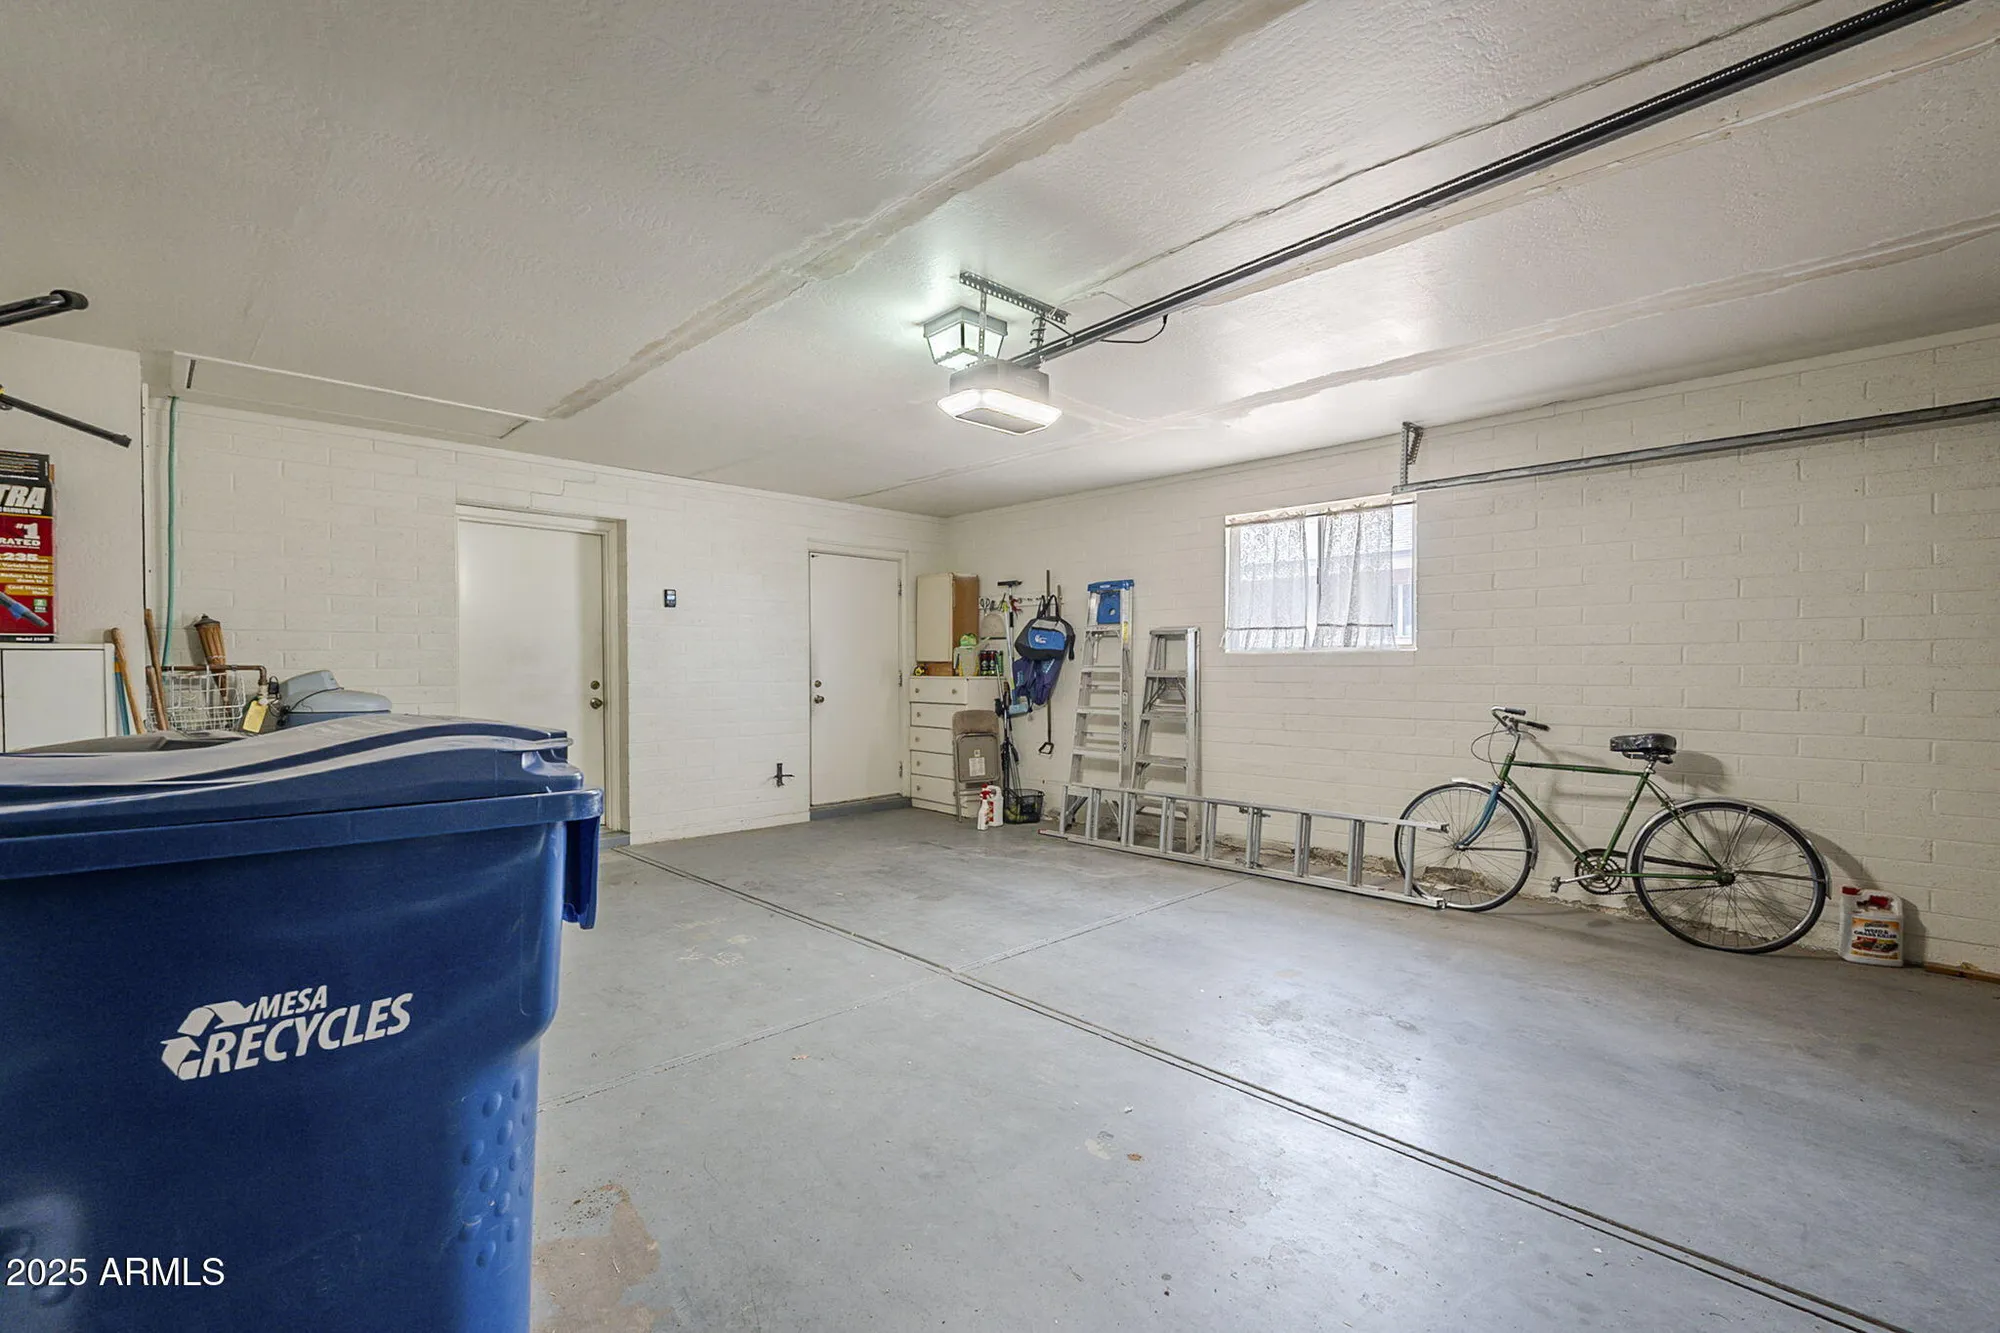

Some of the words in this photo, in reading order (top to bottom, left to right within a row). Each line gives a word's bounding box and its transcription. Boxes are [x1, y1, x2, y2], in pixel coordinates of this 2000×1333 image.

[0, 537, 41, 546] RATED
[254, 985, 327, 1021] MESA
[199, 993, 413, 1078] RECYCLES
